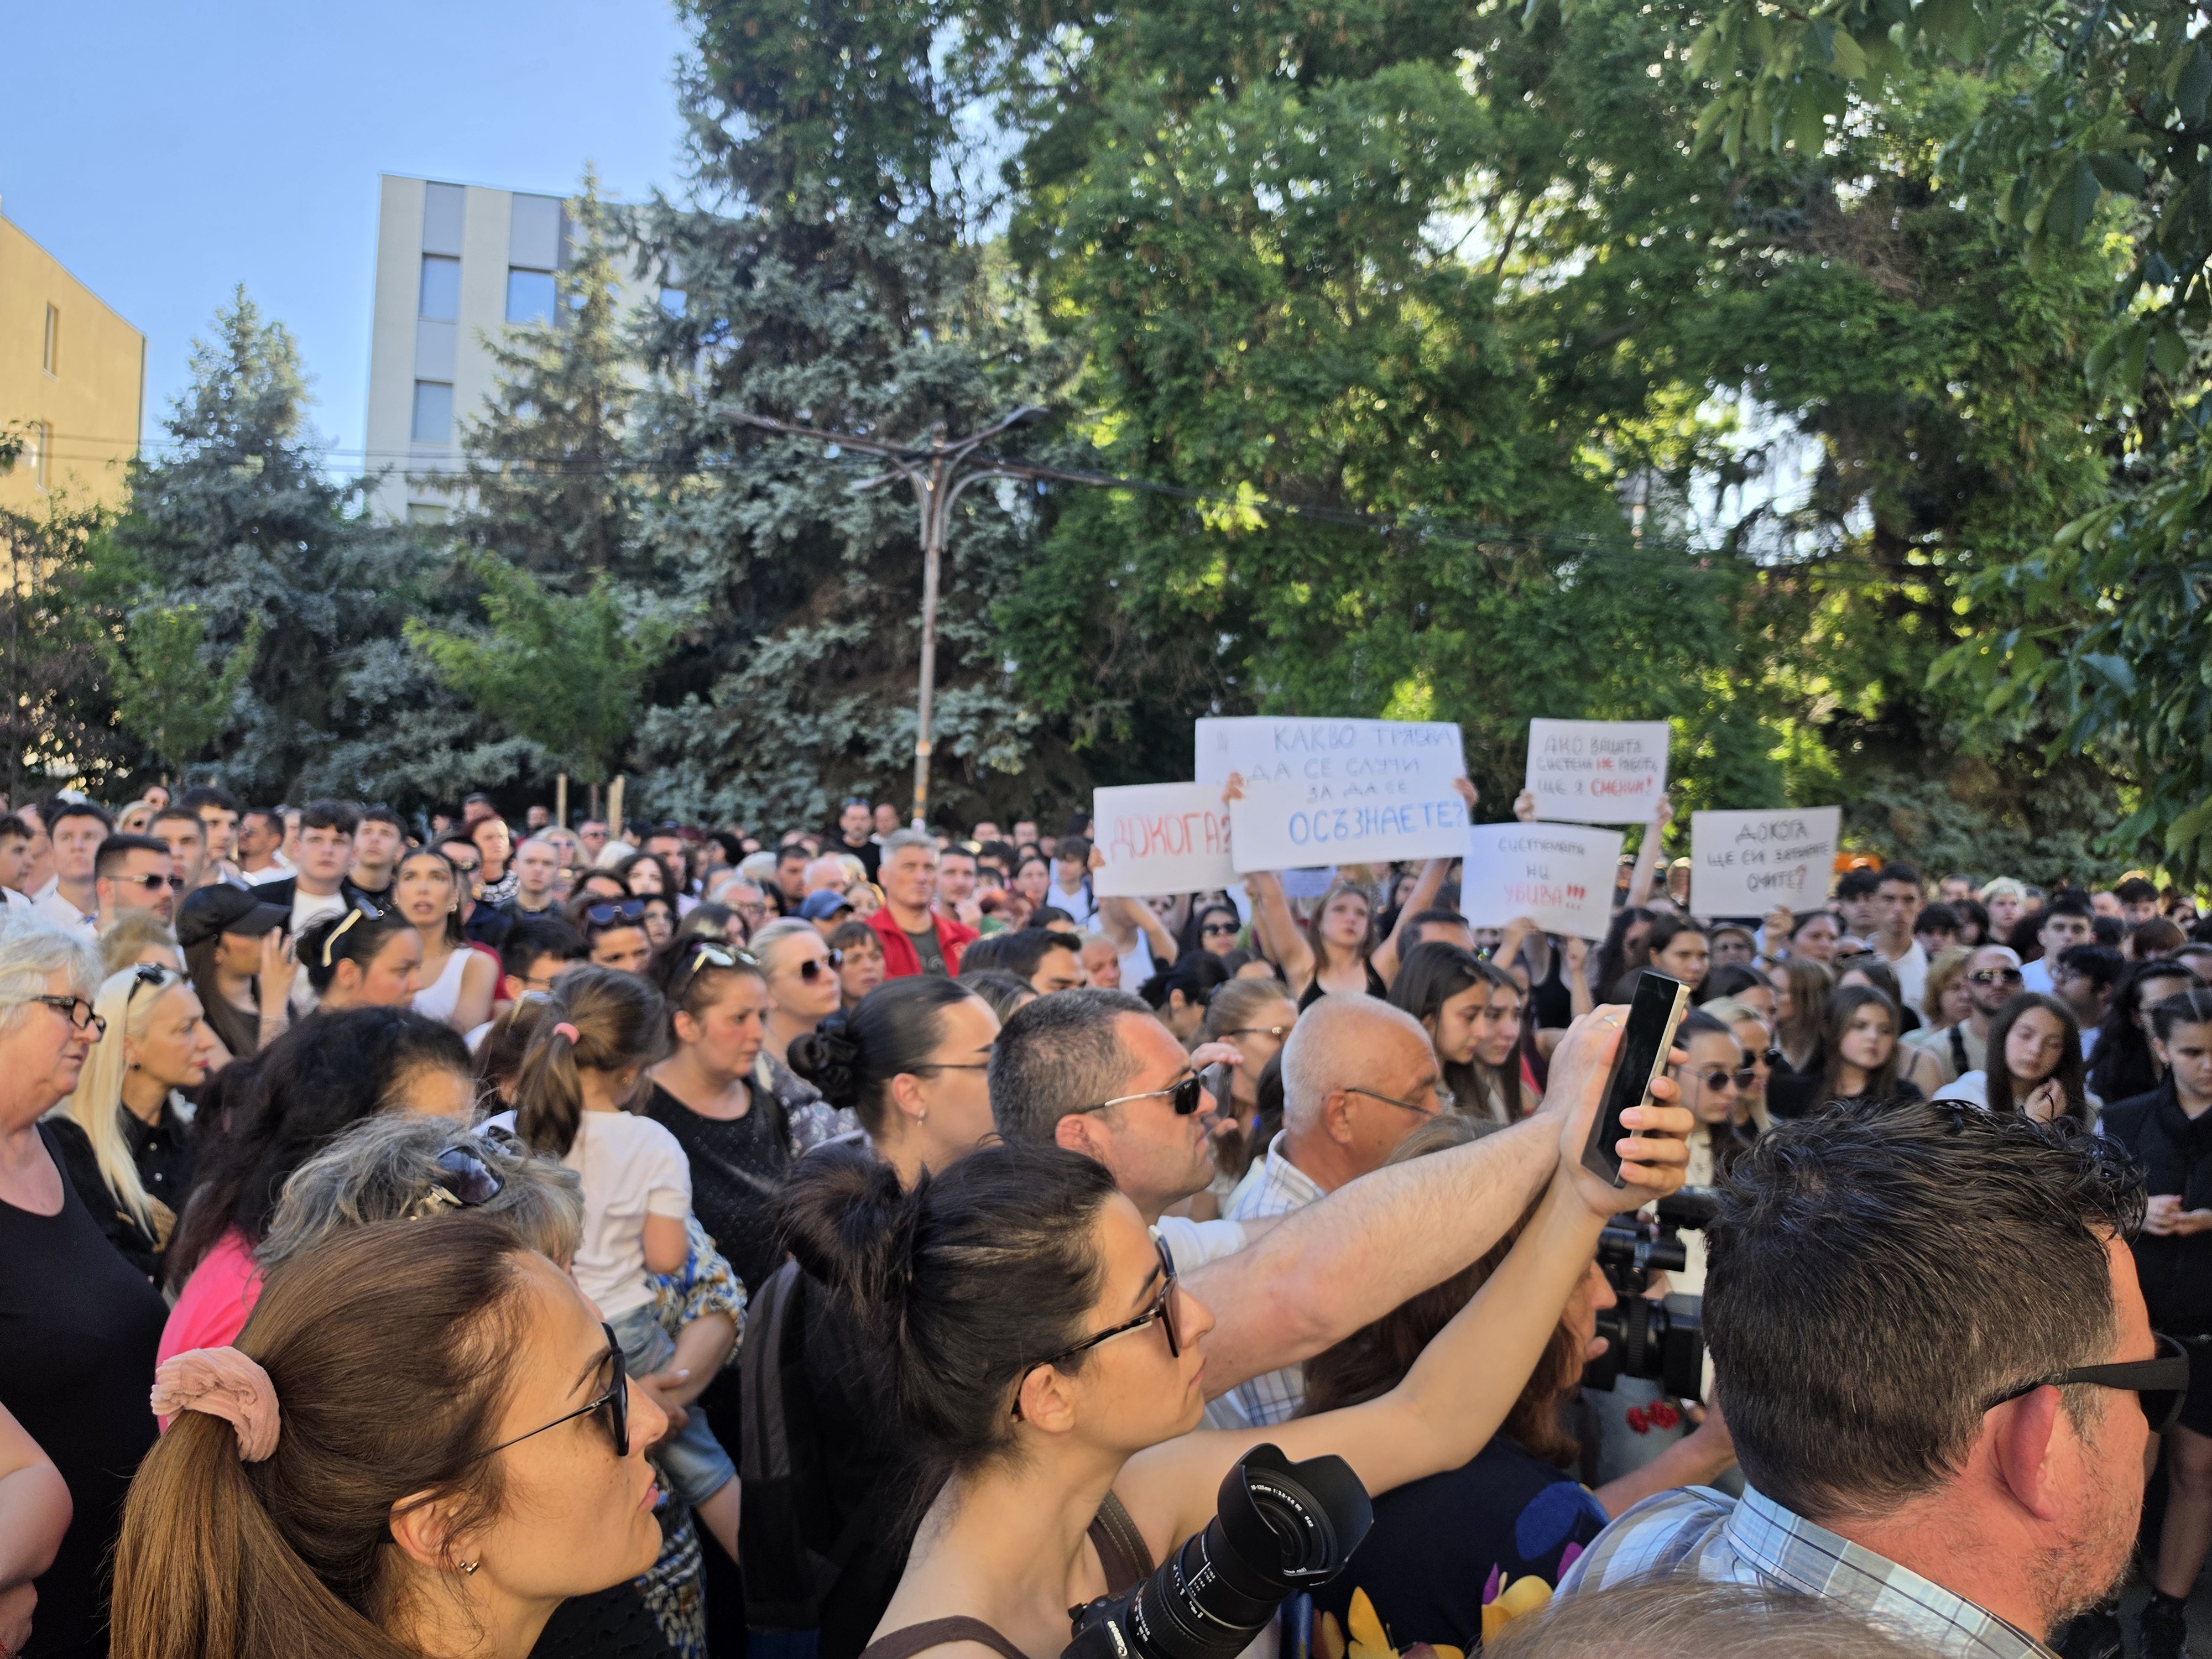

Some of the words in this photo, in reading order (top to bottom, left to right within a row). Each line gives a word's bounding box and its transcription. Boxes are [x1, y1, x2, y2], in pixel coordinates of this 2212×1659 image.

[1274, 724, 1357, 753] КАКВО
[1369, 725, 1454, 747] ТРЯБВА
[1544, 734, 1583, 755] АКО
[1590, 735, 1642, 755] ВАШАТА
[1247, 760, 1291, 784] ДА
[1304, 757, 1332, 780] СЕ
[1346, 757, 1420, 775] СЛУЧИ
[1536, 755, 1593, 771] СИСТЕМА
[1596, 757, 1614, 771] НЕ
[1306, 784, 1332, 804] ЗА
[1344, 782, 1376, 797] ДА
[1385, 780, 1408, 794] СЕ
[1538, 778, 1567, 795] ЩЕ
[1574, 779, 1585, 796] Я
[1110, 810, 1232, 863] ДОКОГА?
[1289, 800, 1464, 846] ОСЪЗНАЕТЕ?
[1735, 818, 1809, 846] ДОКОГА
[1707, 851, 1735, 869] ЩЕ
[1741, 849, 1766, 865] СИ
[1107, 1620, 1128, 1657] Canon
